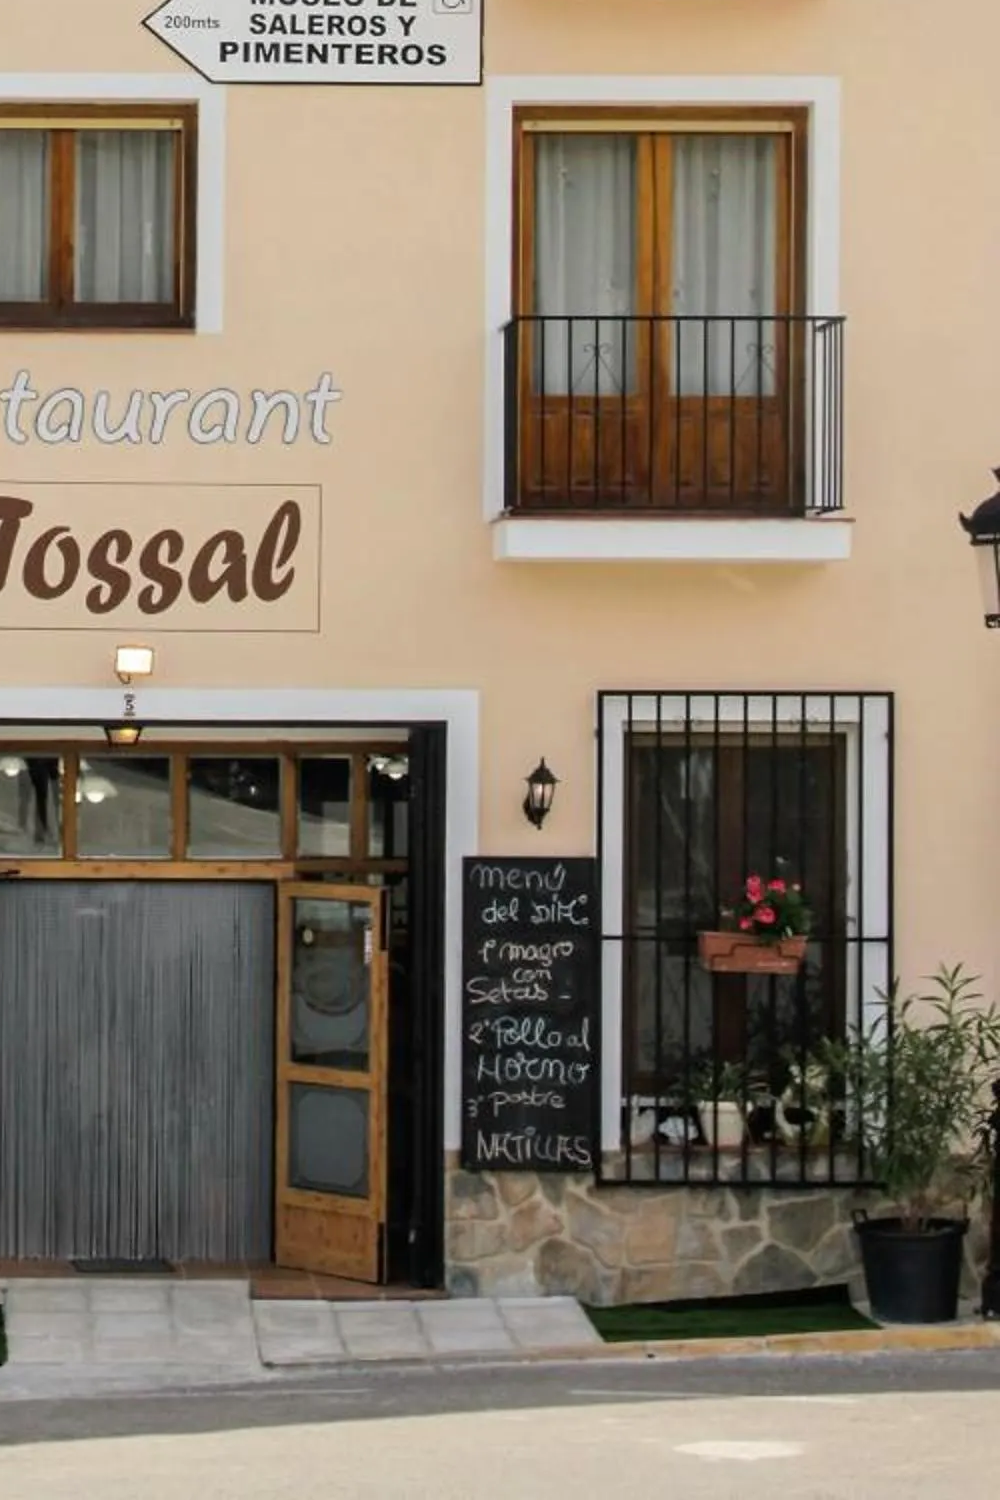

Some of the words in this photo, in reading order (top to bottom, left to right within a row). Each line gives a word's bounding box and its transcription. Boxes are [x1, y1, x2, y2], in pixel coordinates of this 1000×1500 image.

[163, 15, 220, 29] 200mts
[249, 13, 387, 36] SALEROS
[398, 16, 417, 36] Y
[219, 41, 448, 65] PIMENTEROS
[481, 897, 519, 924] del
